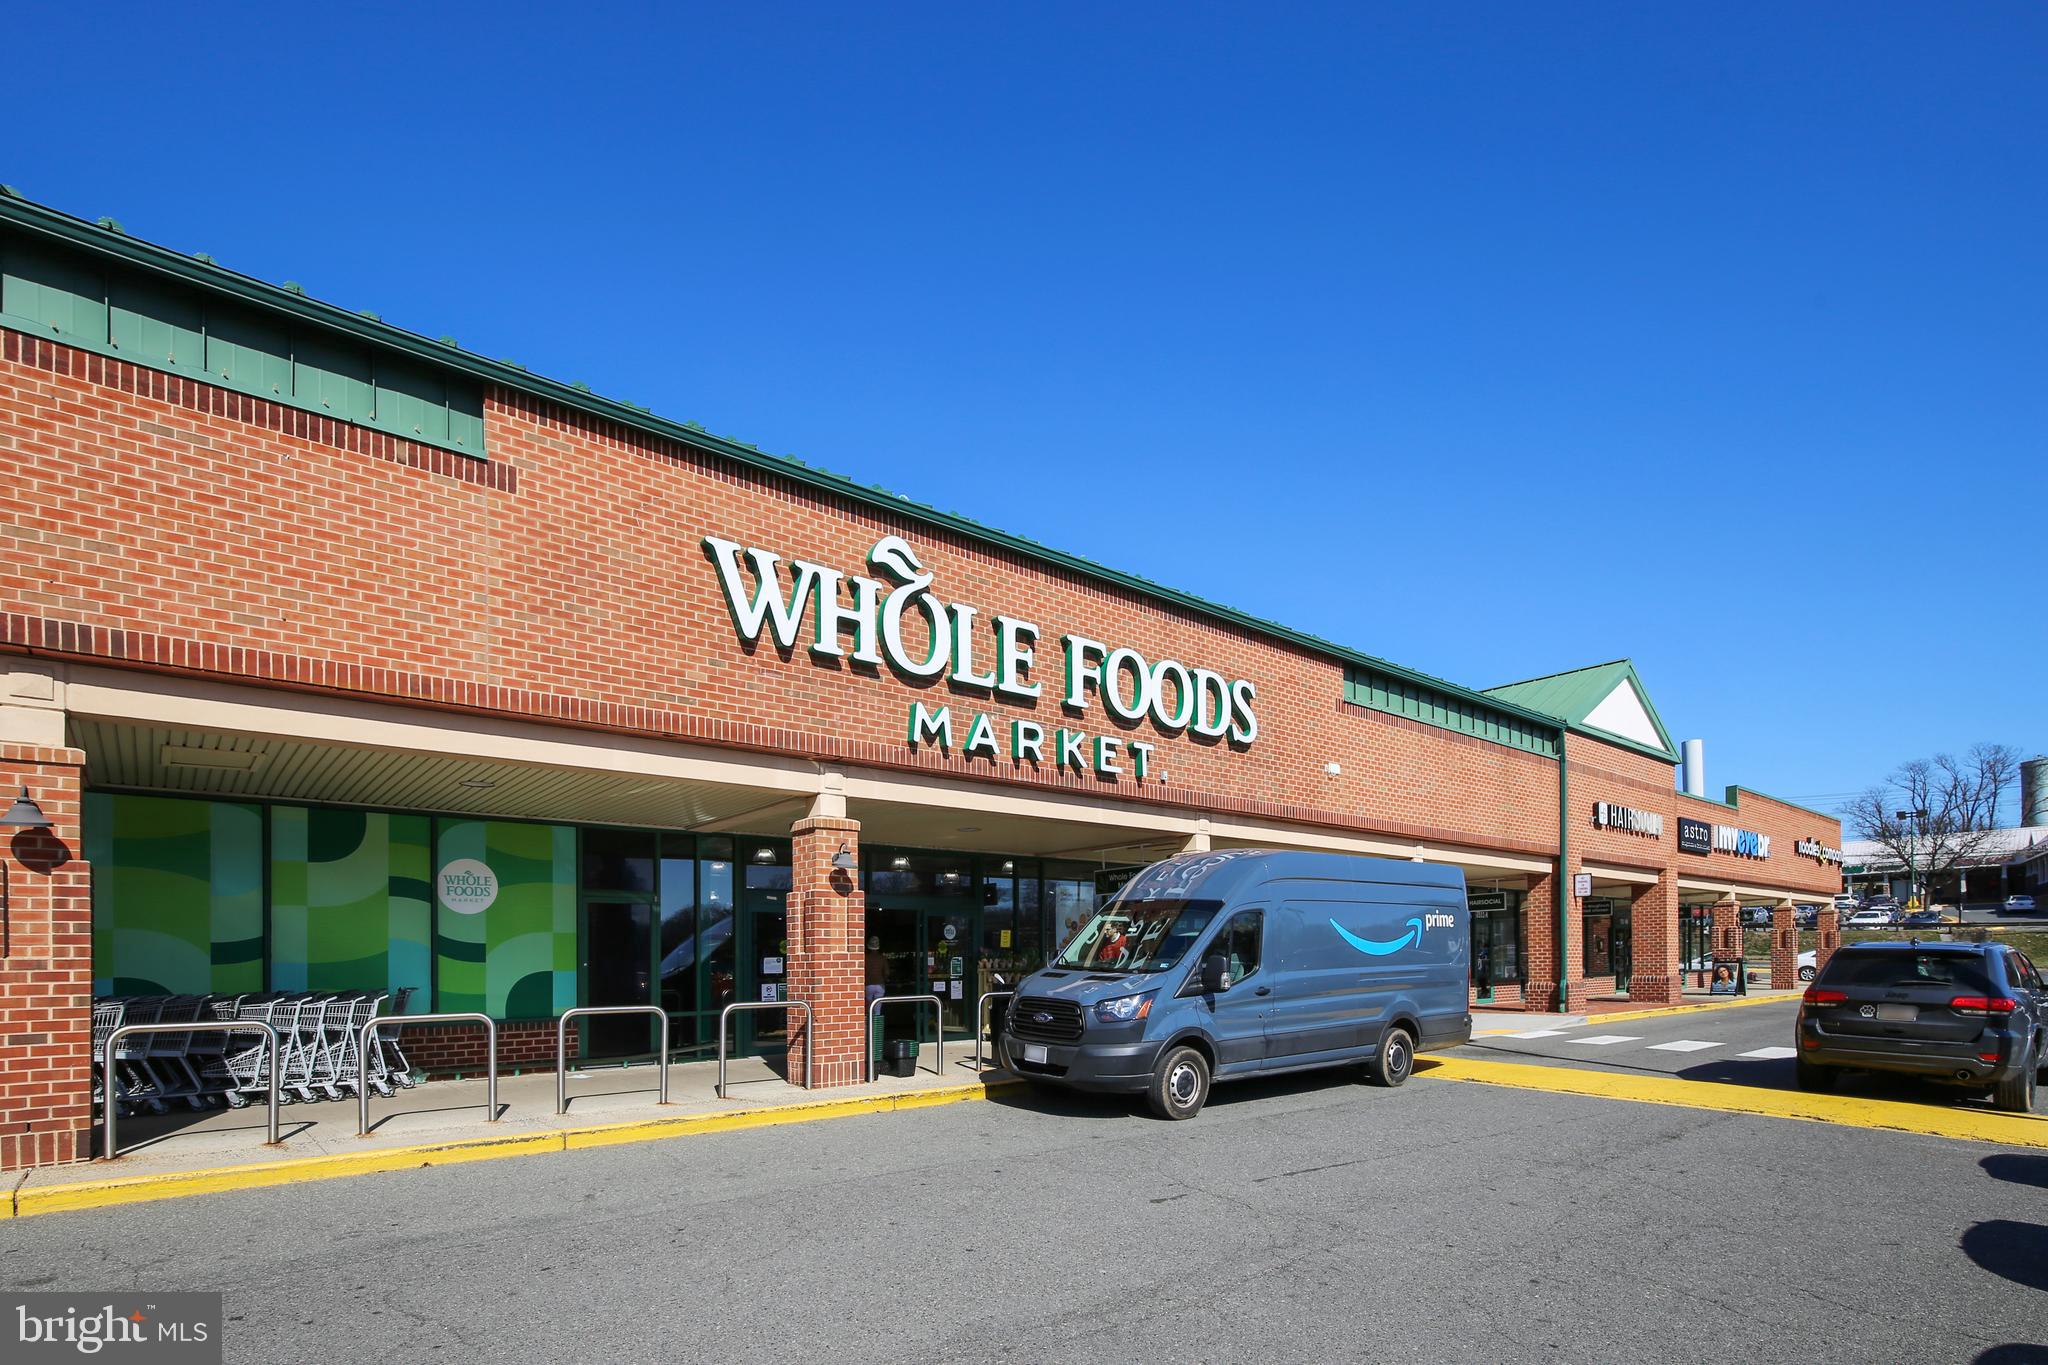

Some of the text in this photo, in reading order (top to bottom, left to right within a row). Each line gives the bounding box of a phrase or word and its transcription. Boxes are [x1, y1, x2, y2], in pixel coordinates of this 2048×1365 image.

[702, 535, 1258, 744] WHOLE FOODS
[911, 701, 1155, 778] MARKET
[1684, 824, 1708, 841] astro
[443, 870, 492, 886] WHOLE
[446, 886, 491, 897] FOODS
[1425, 909, 1455, 931] prime
